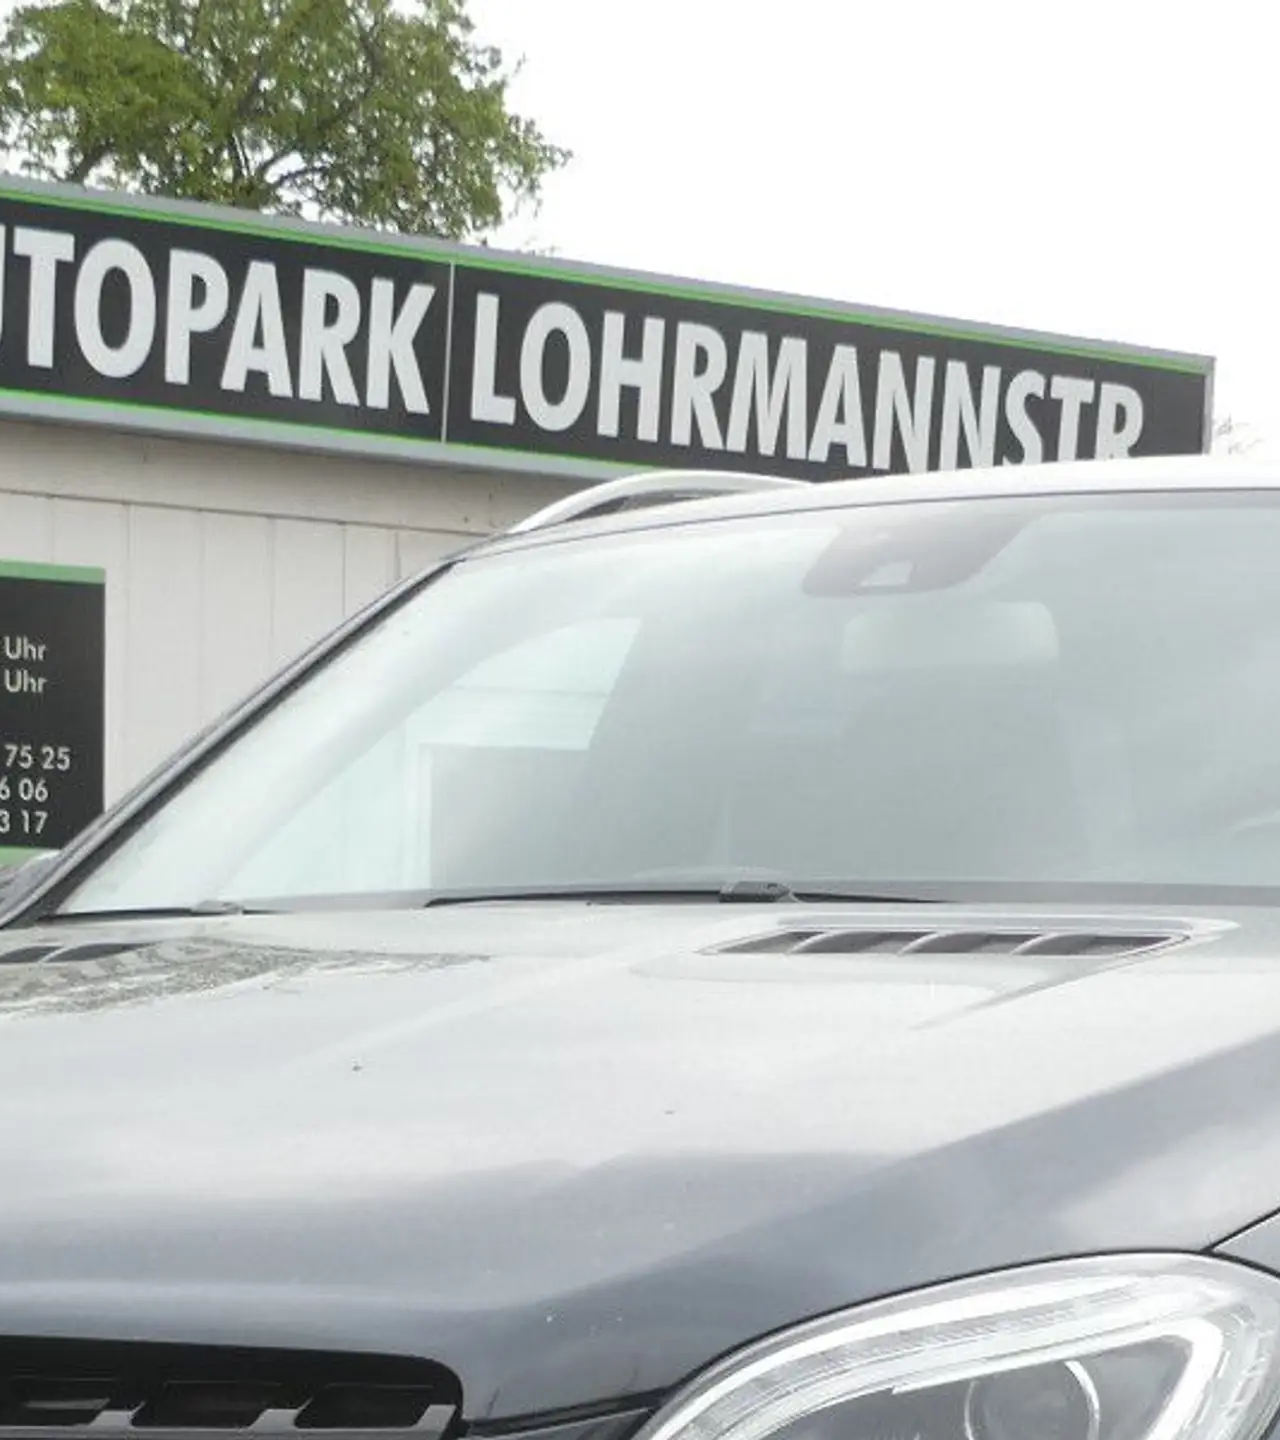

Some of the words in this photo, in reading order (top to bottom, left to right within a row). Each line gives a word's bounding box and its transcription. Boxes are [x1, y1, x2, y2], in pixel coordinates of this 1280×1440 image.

[470, 292, 1144, 475] LOHRMANNSTR
[4, 634, 47, 661] Uhr
[4, 668, 48, 693] Uhr
[4, 744, 34, 769] 75
[41, 746, 71, 771] 25
[18, 777, 49, 802] 06
[21, 810, 48, 834] 17
